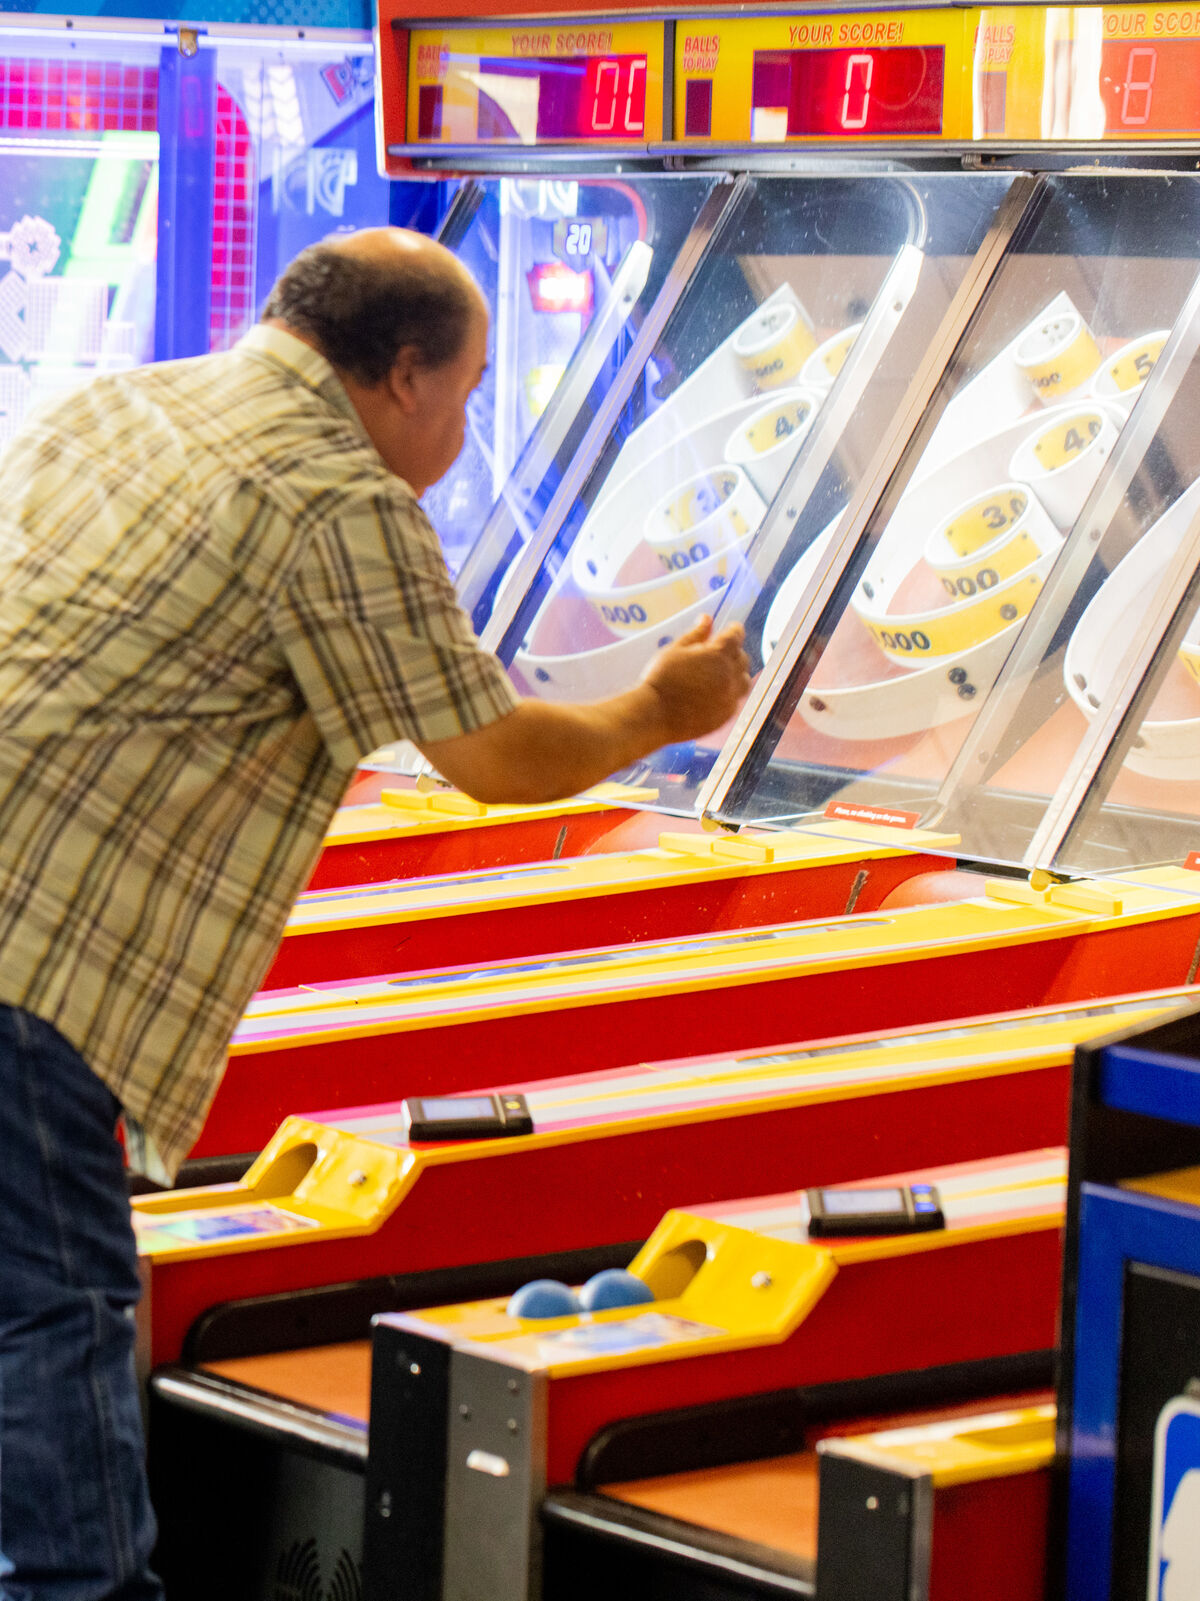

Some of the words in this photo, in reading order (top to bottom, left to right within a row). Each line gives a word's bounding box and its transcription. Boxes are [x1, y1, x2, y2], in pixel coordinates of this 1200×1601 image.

[788, 24, 833, 44] YOUR
[839, 22, 904, 42] SCORE!
[1103, 13, 1147, 35] OUR
[511, 34, 552, 51] YOUR
[555, 31, 613, 50] SCORE!
[974, 25, 1014, 44] ALLS
[684, 36, 719, 54] BALLS
[695, 56, 718, 70] PLAY
[841, 54, 873, 129] 0
